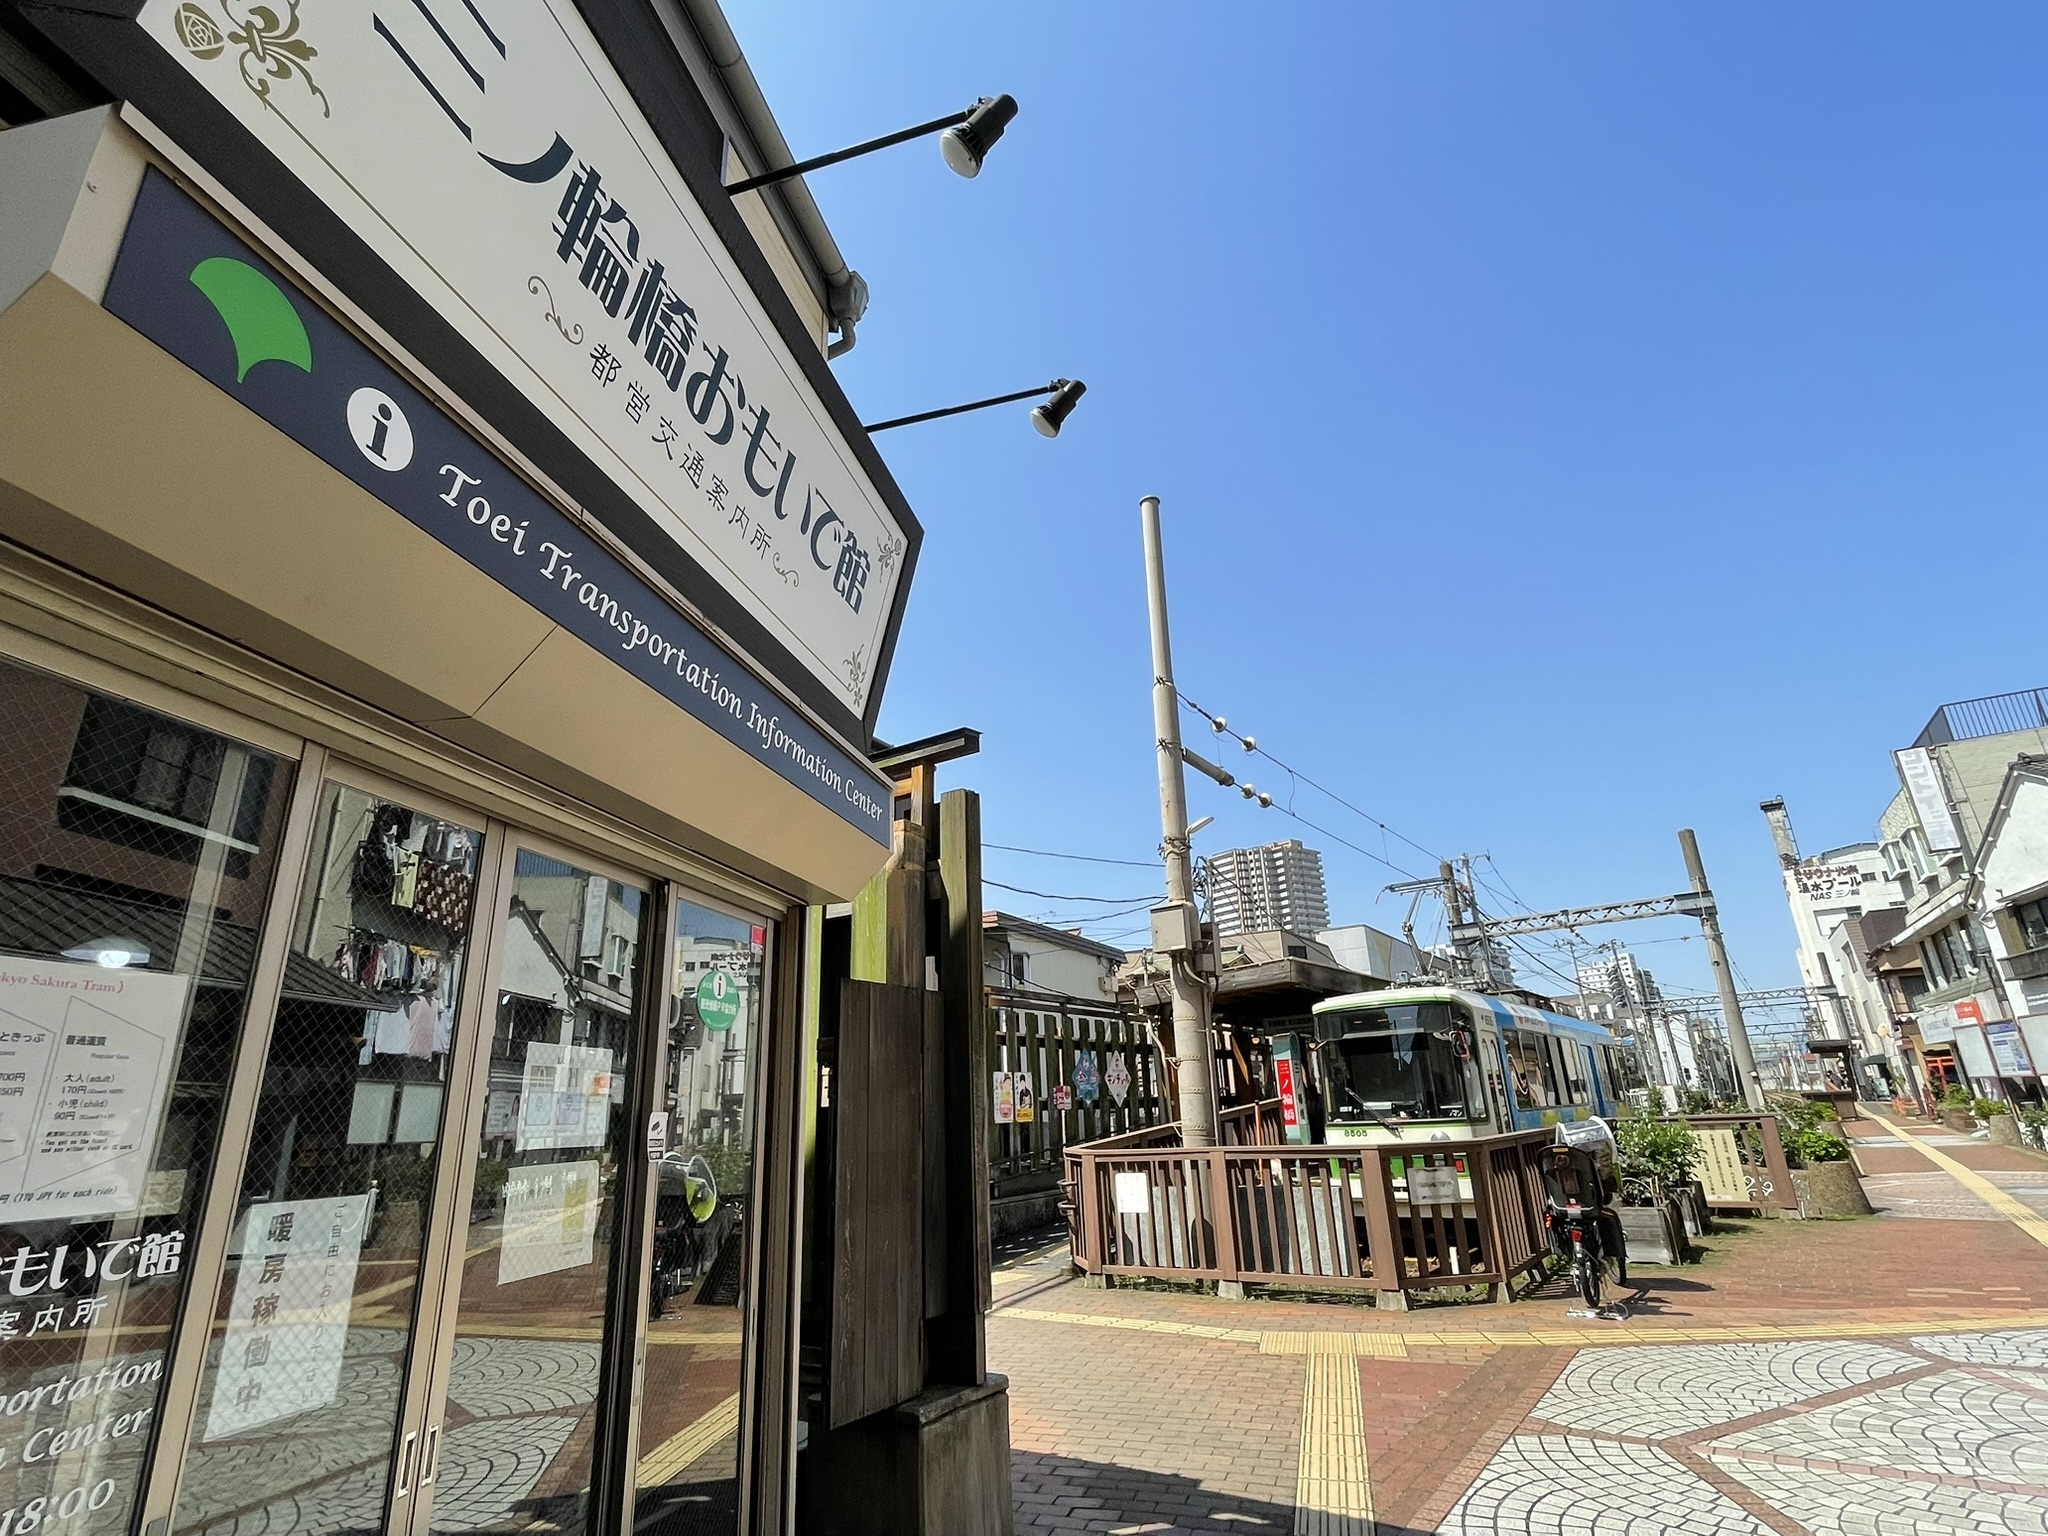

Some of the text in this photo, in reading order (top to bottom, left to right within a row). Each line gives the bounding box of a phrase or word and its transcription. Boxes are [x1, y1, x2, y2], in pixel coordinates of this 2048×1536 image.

[373, 0, 872, 614] 三ノ輪橋おもいで館
[589, 343, 773, 562] 都営交通案内所
[439, 464, 529, 555] Toei
[539, 542, 743, 719] Transportation
[747, 702, 842, 795] Information
[845, 779, 883, 821] Center
[1810, 892, 1832, 901] NAS
[0, 971, 124, 994] kyo Sakura Tram)
[0, 1031, 46, 1043] ときっぷ
[0, 1086, 24, 1096] 50円
[61, 1085, 87, 1095] 170円
[1279, 1062, 1296, 1121] 三ノ輪橋
[54, 1111, 75, 1120] 90円
[1344, 1129, 1368, 1137] 8505
[55, 1190, 71, 1199] for
[73, 1188, 92, 1198] each
[0, 1230, 186, 1296] もいで館
[22, 1406, 153, 1464] Center
